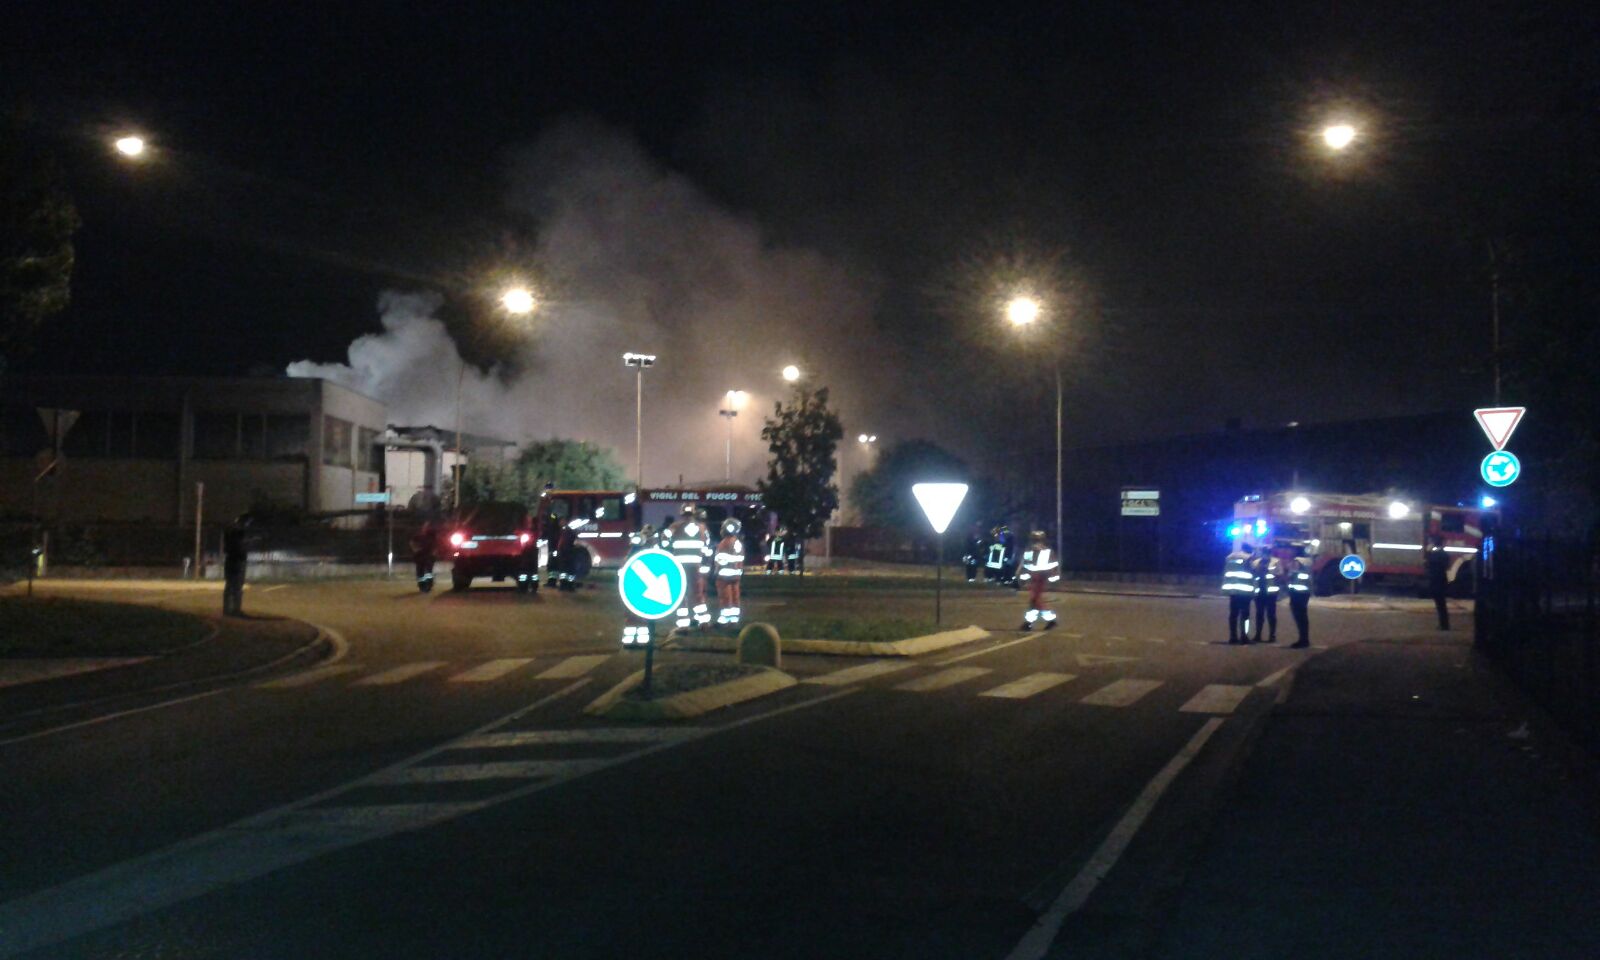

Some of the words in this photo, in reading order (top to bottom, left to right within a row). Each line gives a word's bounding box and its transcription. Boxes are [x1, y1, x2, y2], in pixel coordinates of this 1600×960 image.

[650, 492, 678, 500] VIGILI
[681, 492, 700, 500] DEL
[706, 493, 738, 501] FUOCO
